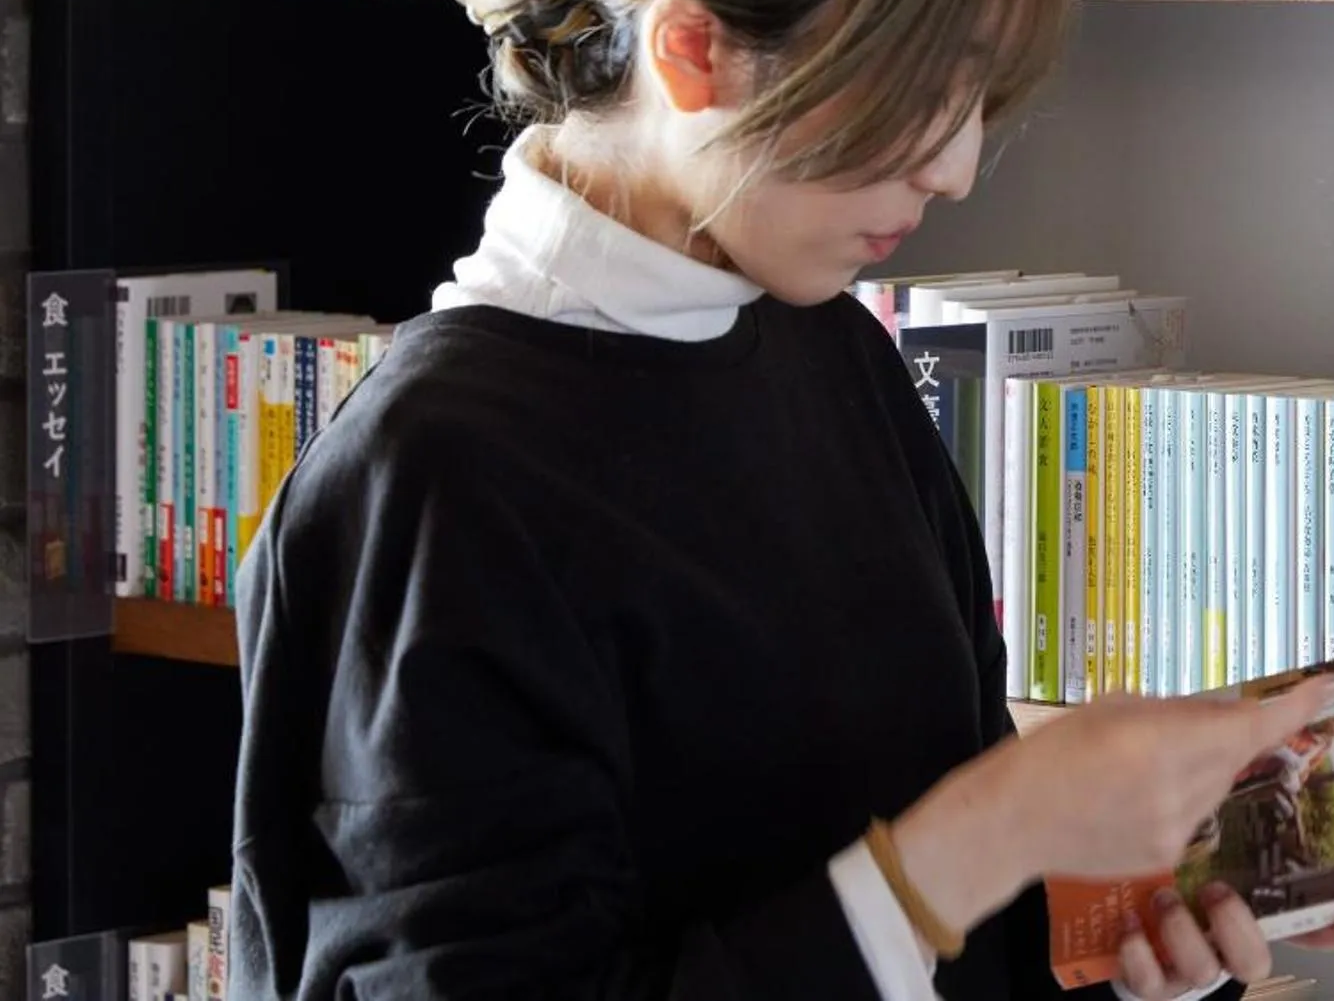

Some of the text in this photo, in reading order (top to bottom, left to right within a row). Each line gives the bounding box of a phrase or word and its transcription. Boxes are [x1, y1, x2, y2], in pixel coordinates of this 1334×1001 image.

[41, 292, 69, 478] 食 エッセイ
[41, 963, 69, 999] 食
